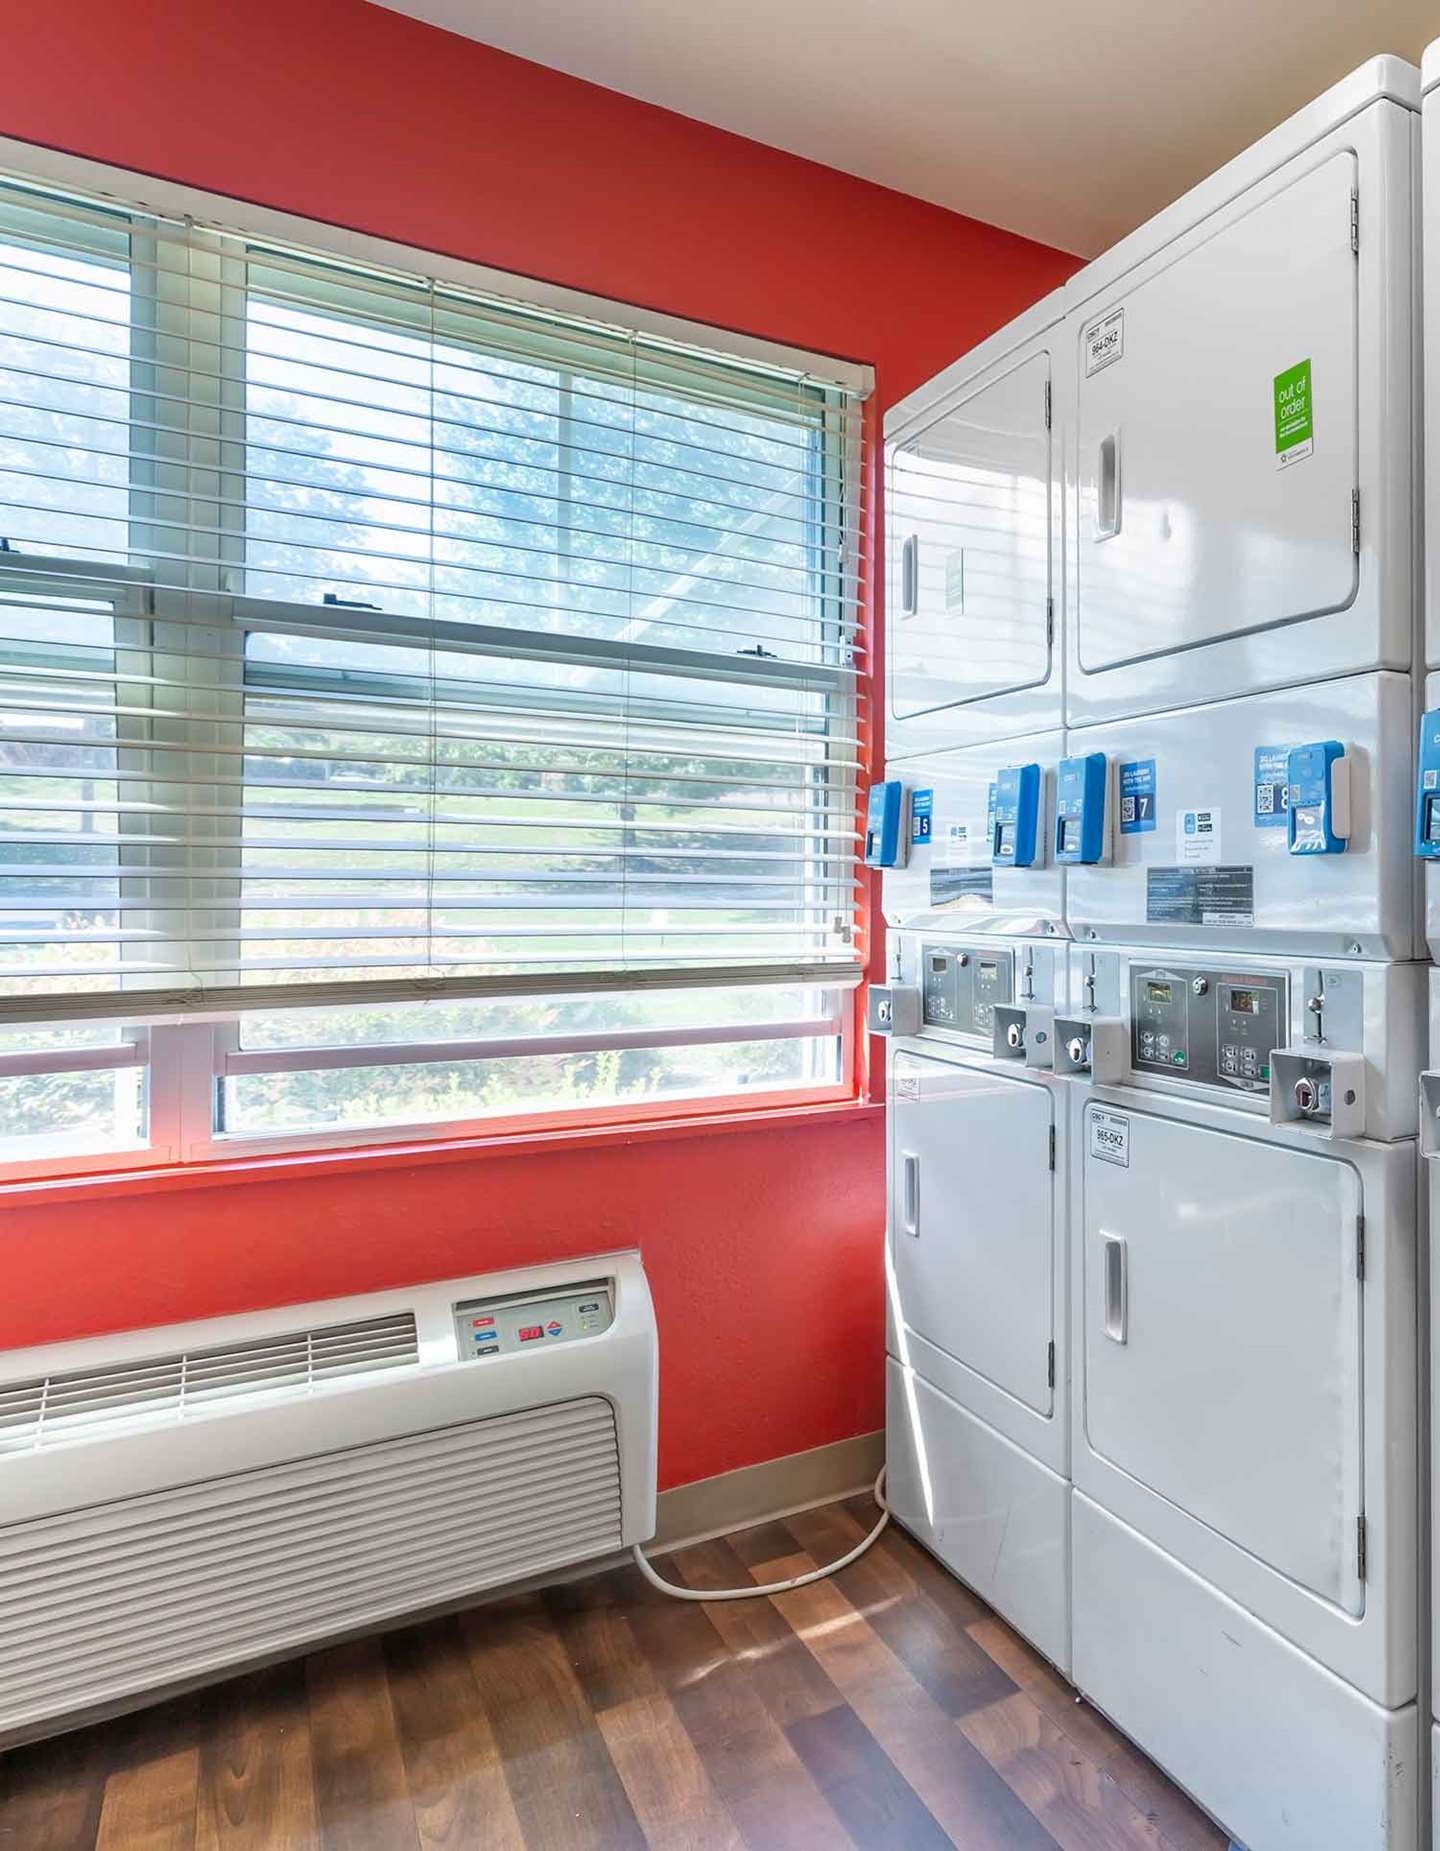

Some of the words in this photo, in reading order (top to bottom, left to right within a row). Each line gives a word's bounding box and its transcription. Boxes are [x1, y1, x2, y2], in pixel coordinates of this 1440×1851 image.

[1279, 384, 1294, 403] out
[1297, 376, 1306, 394] of
[1281, 397, 1305, 419] order
[1140, 798, 1149, 818] 7
